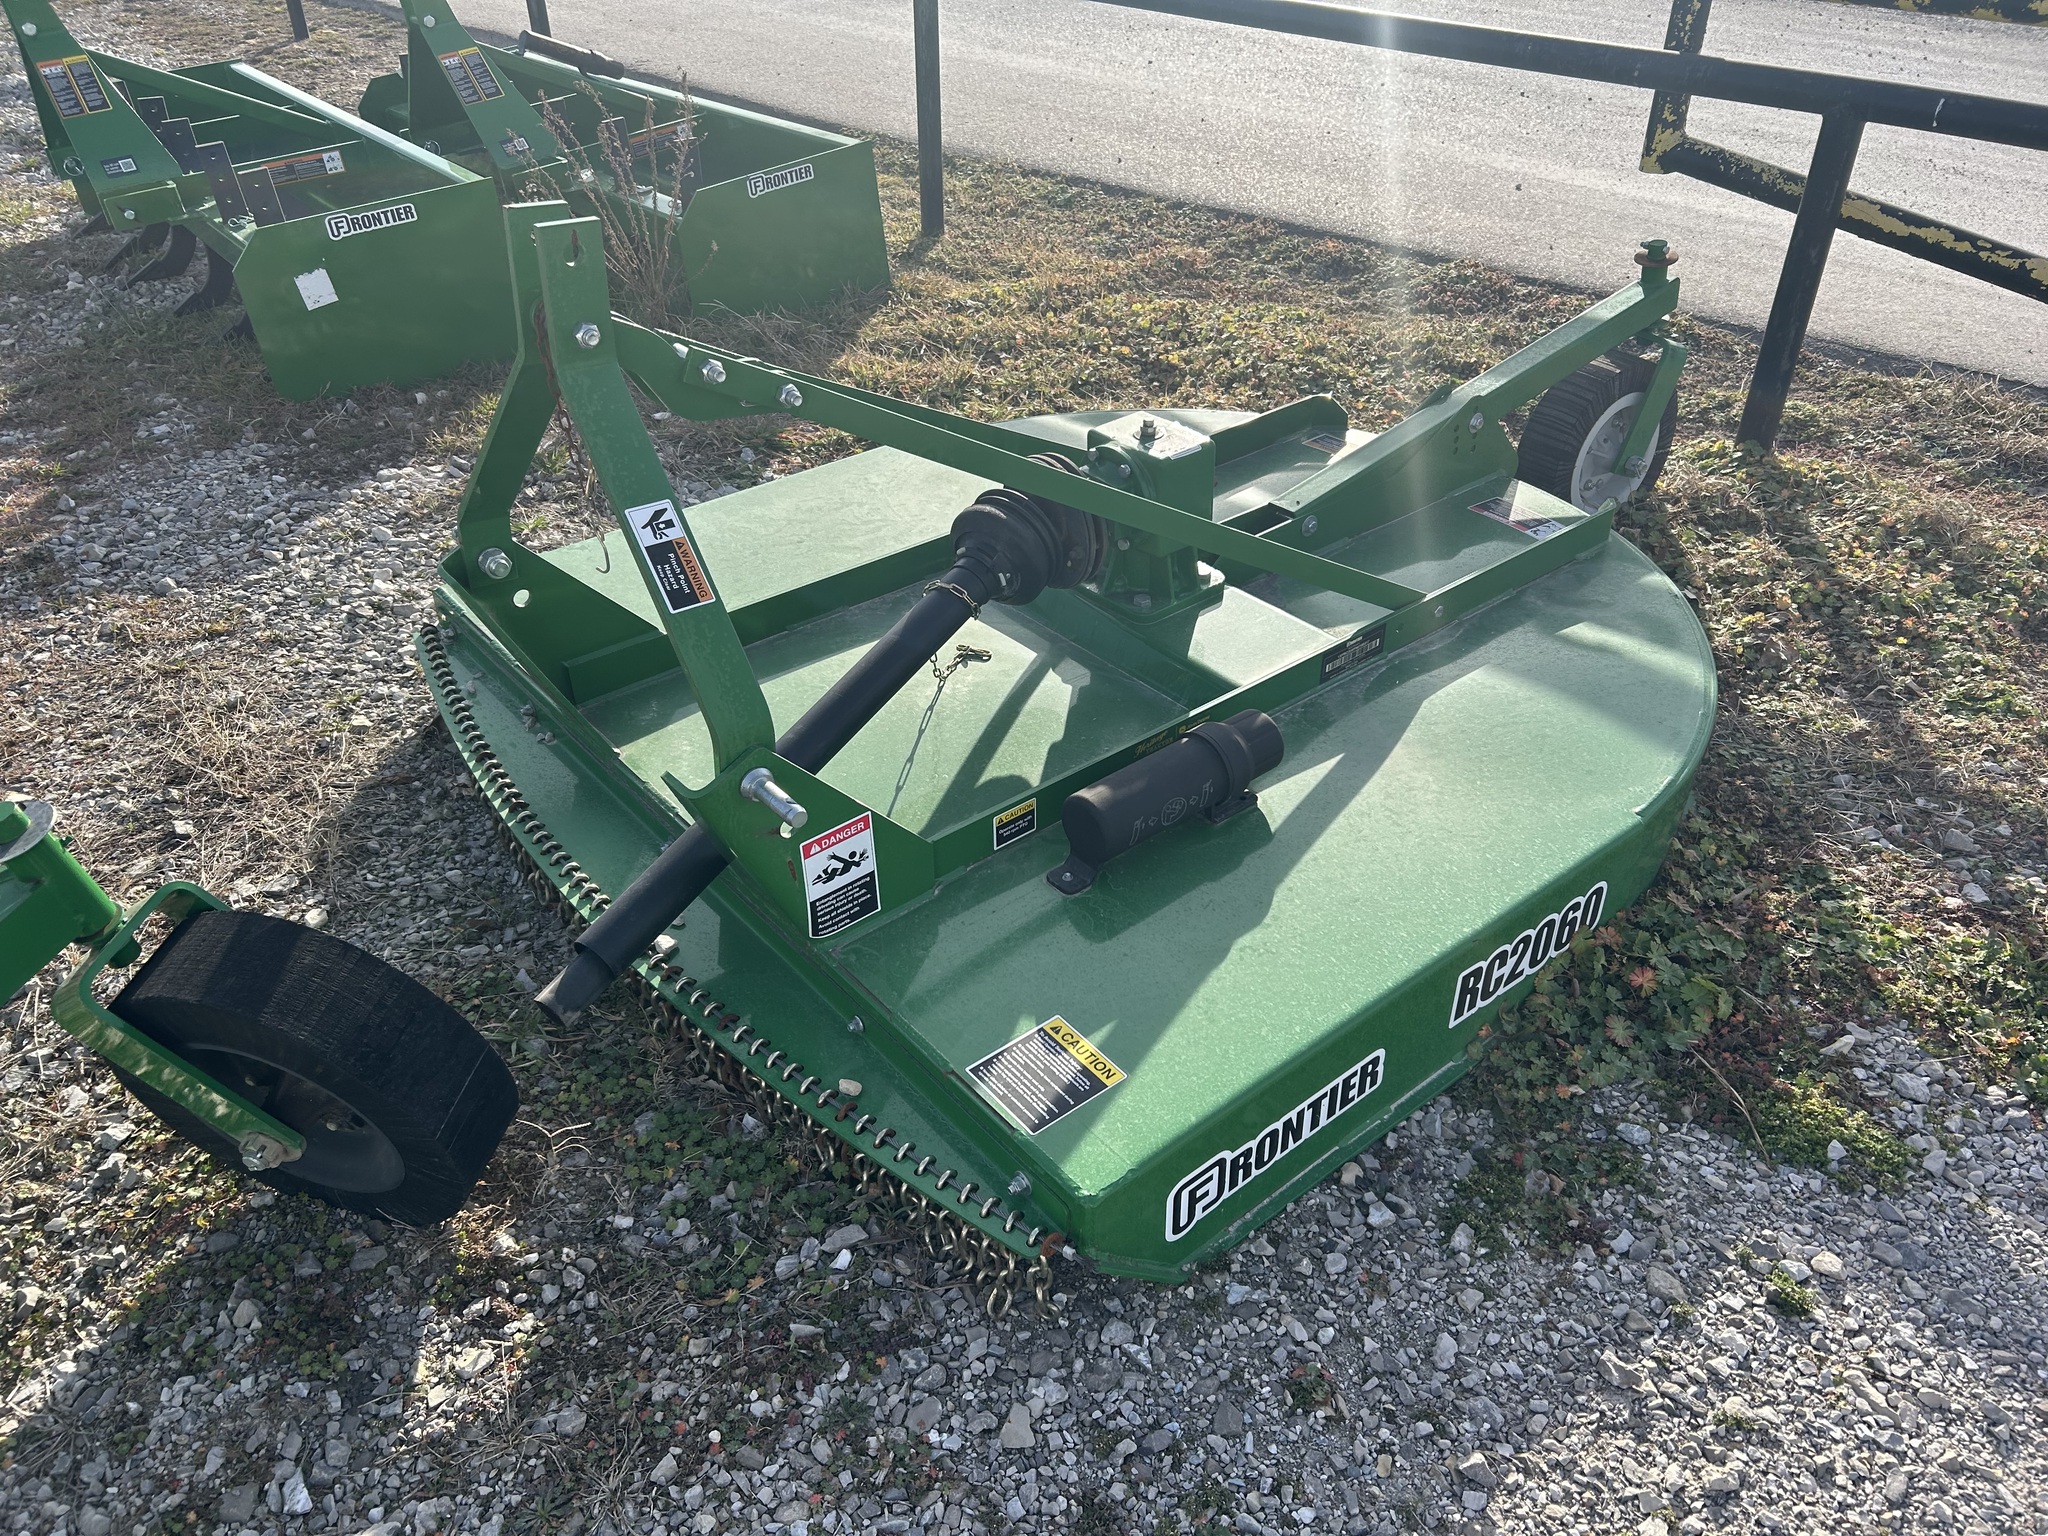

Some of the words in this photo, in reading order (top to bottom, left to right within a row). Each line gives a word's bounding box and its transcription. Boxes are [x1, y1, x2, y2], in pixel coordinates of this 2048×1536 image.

[750, 164, 812, 196] FRONTIER
[327, 205, 415, 238] FRONTIER
[664, 564, 679, 589] Hazard
[668, 553, 680, 573] Pinch
[678, 575, 690, 593] Point
[680, 549, 707, 598] WARNING
[1005, 802, 1033, 820] CAUTION
[822, 822, 864, 848] DANGER
[816, 888, 847, 906] Entanglement
[846, 888, 859, 896] cause
[1454, 886, 1605, 1022] RC2060
[1061, 1032, 1116, 1080] CAUTION
[1173, 1054, 1381, 1236] FRONTIER
